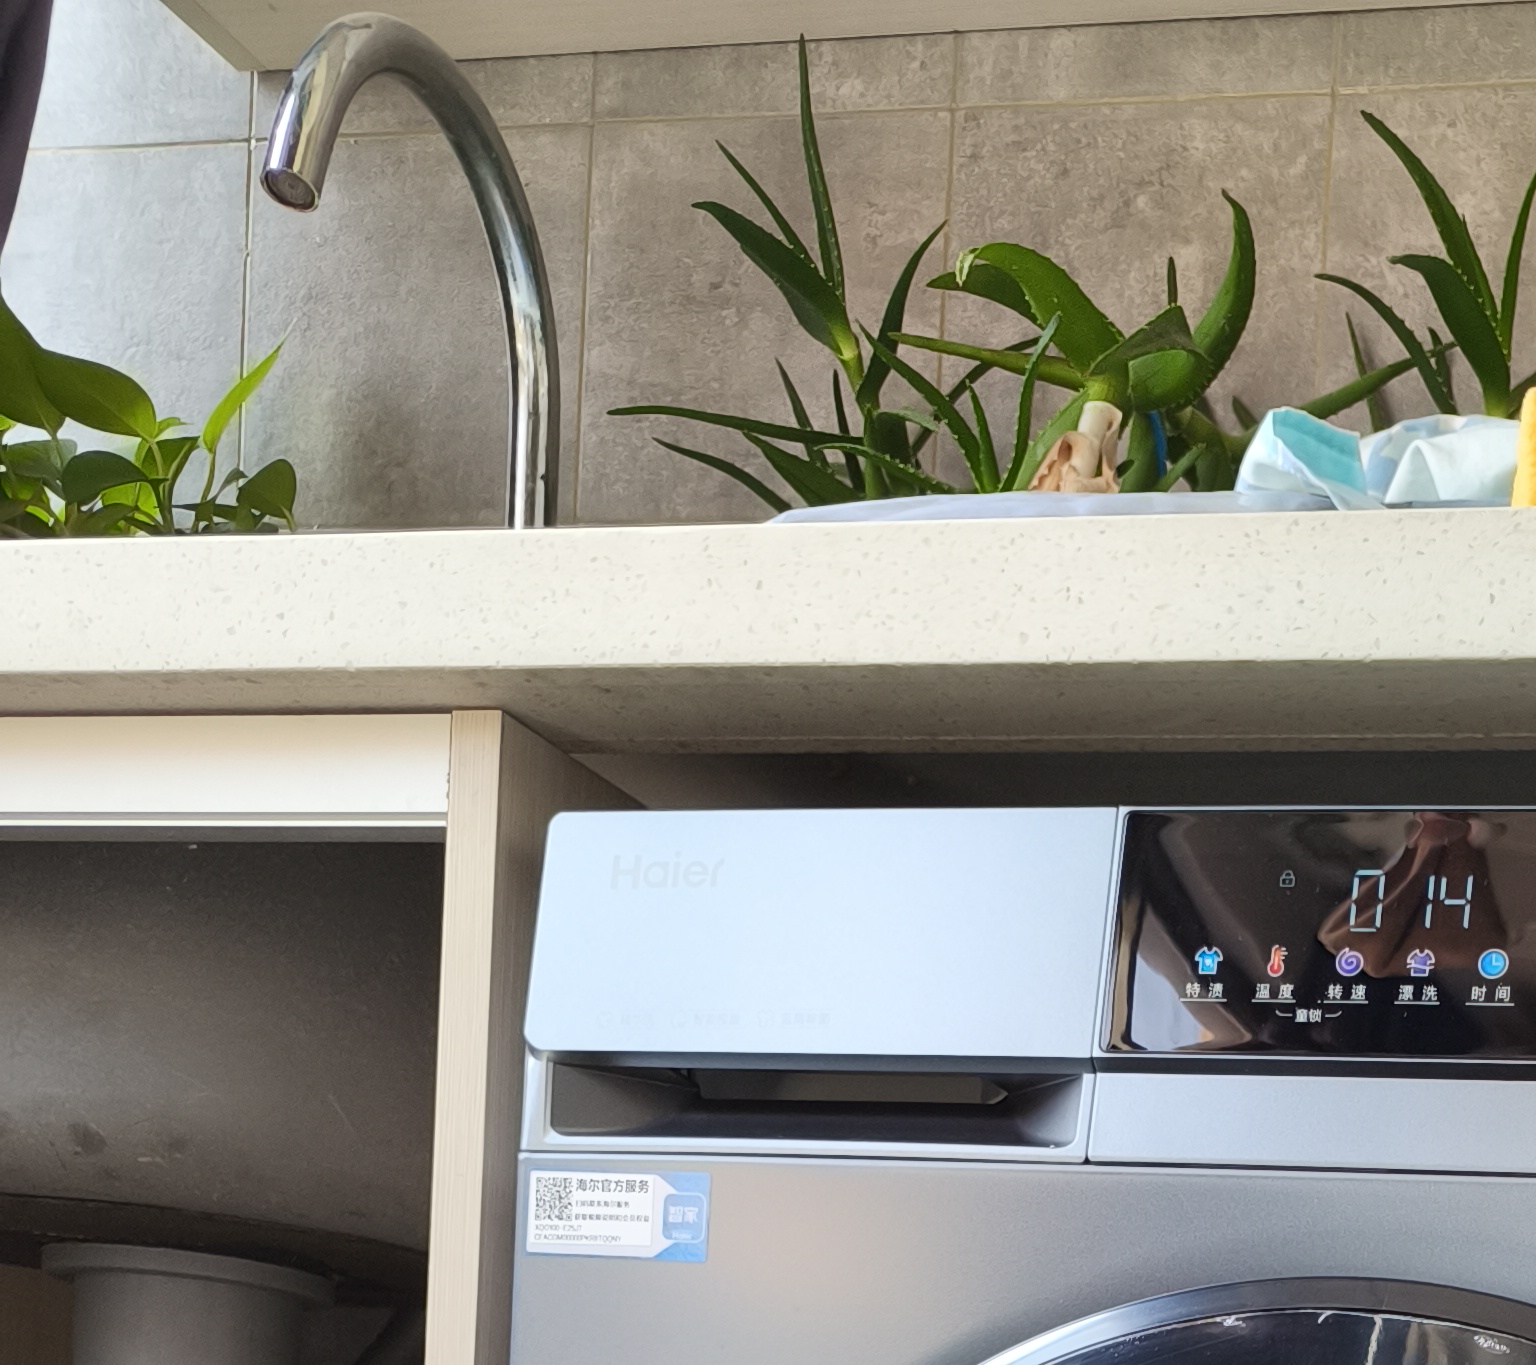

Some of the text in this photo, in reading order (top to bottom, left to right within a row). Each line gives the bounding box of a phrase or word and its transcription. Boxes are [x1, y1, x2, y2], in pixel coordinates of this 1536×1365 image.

[610, 850, 726, 890] Haier
[1185, 982, 1224, 998] 特渍
[1255, 982, 1295, 999] 温度
[1326, 983, 1367, 1000] 转速
[1397, 984, 1438, 1001] 漂洗
[1470, 985, 1511, 1002] 时间
[575, 1178, 650, 1194] 海尔官方服务
